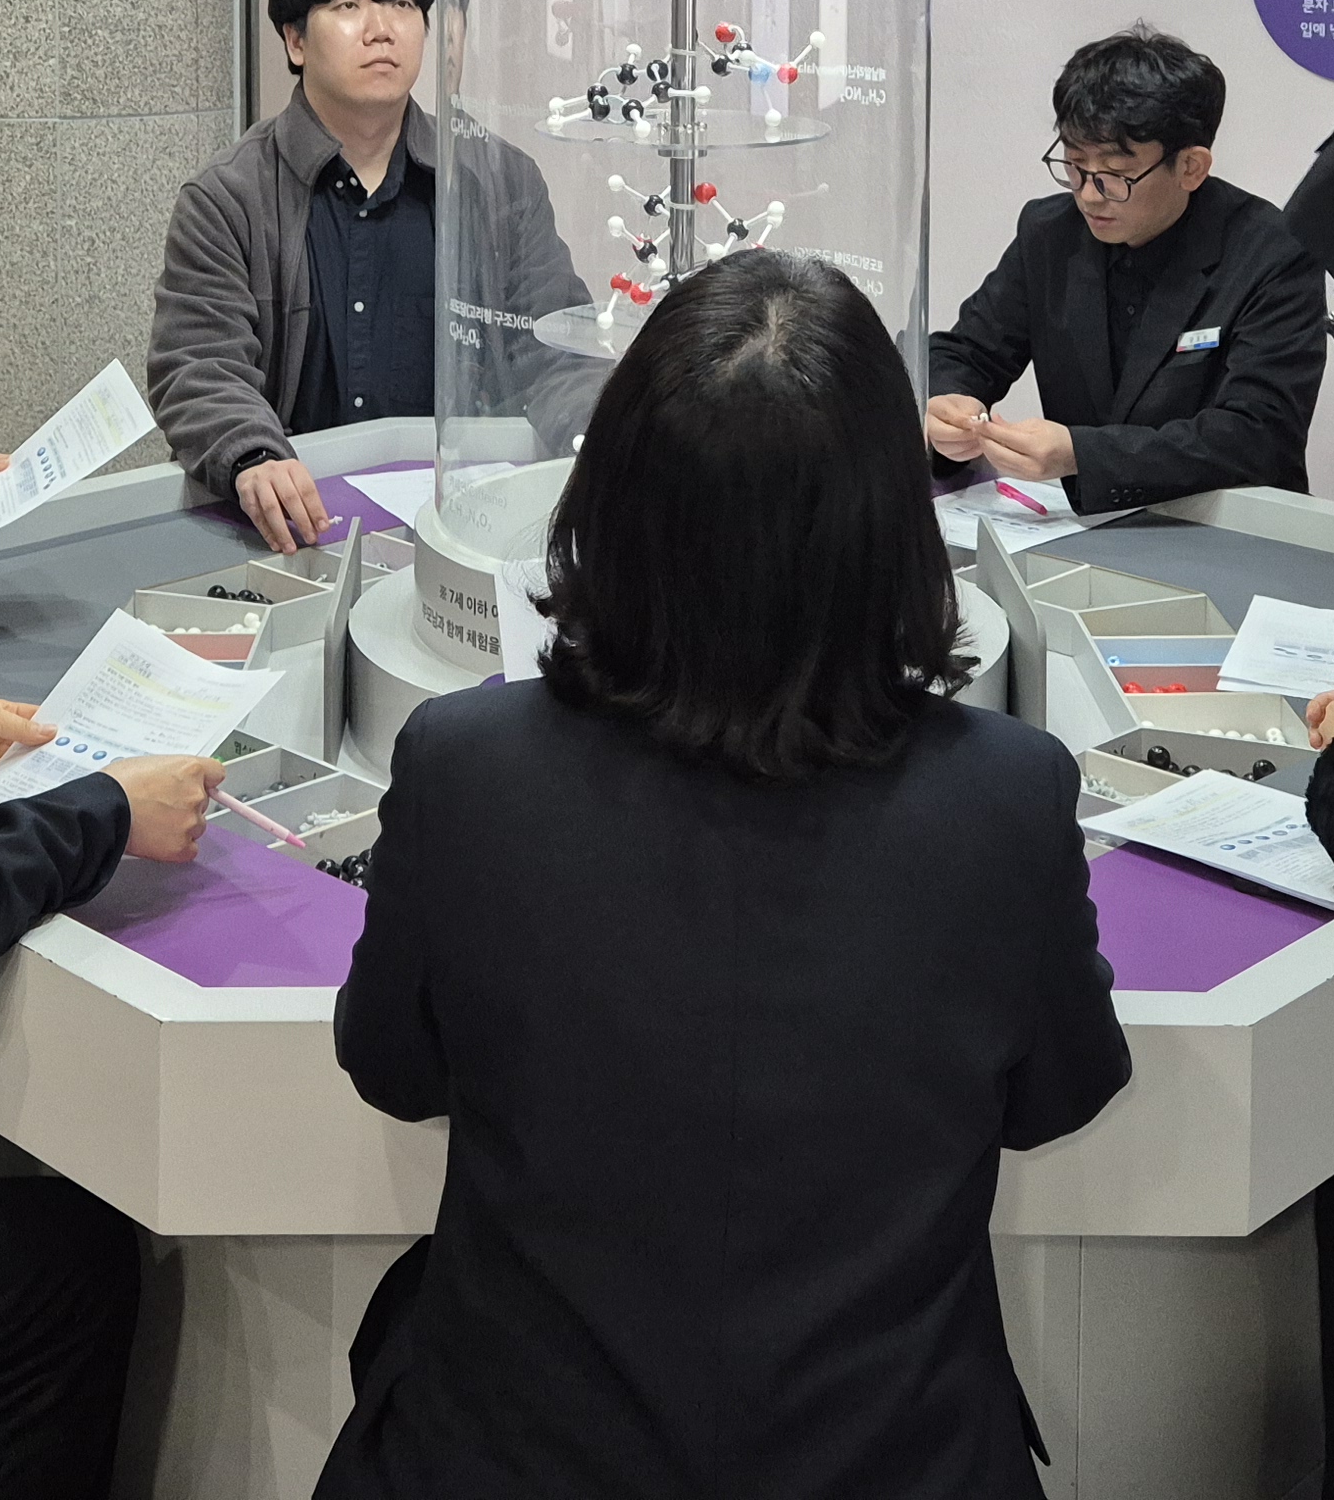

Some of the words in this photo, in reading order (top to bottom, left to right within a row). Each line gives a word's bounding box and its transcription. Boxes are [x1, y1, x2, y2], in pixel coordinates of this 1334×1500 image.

[1300, 22, 1326, 38] 입에
[466, 596, 488, 620] 이하
[466, 629, 500, 656] 체험을
